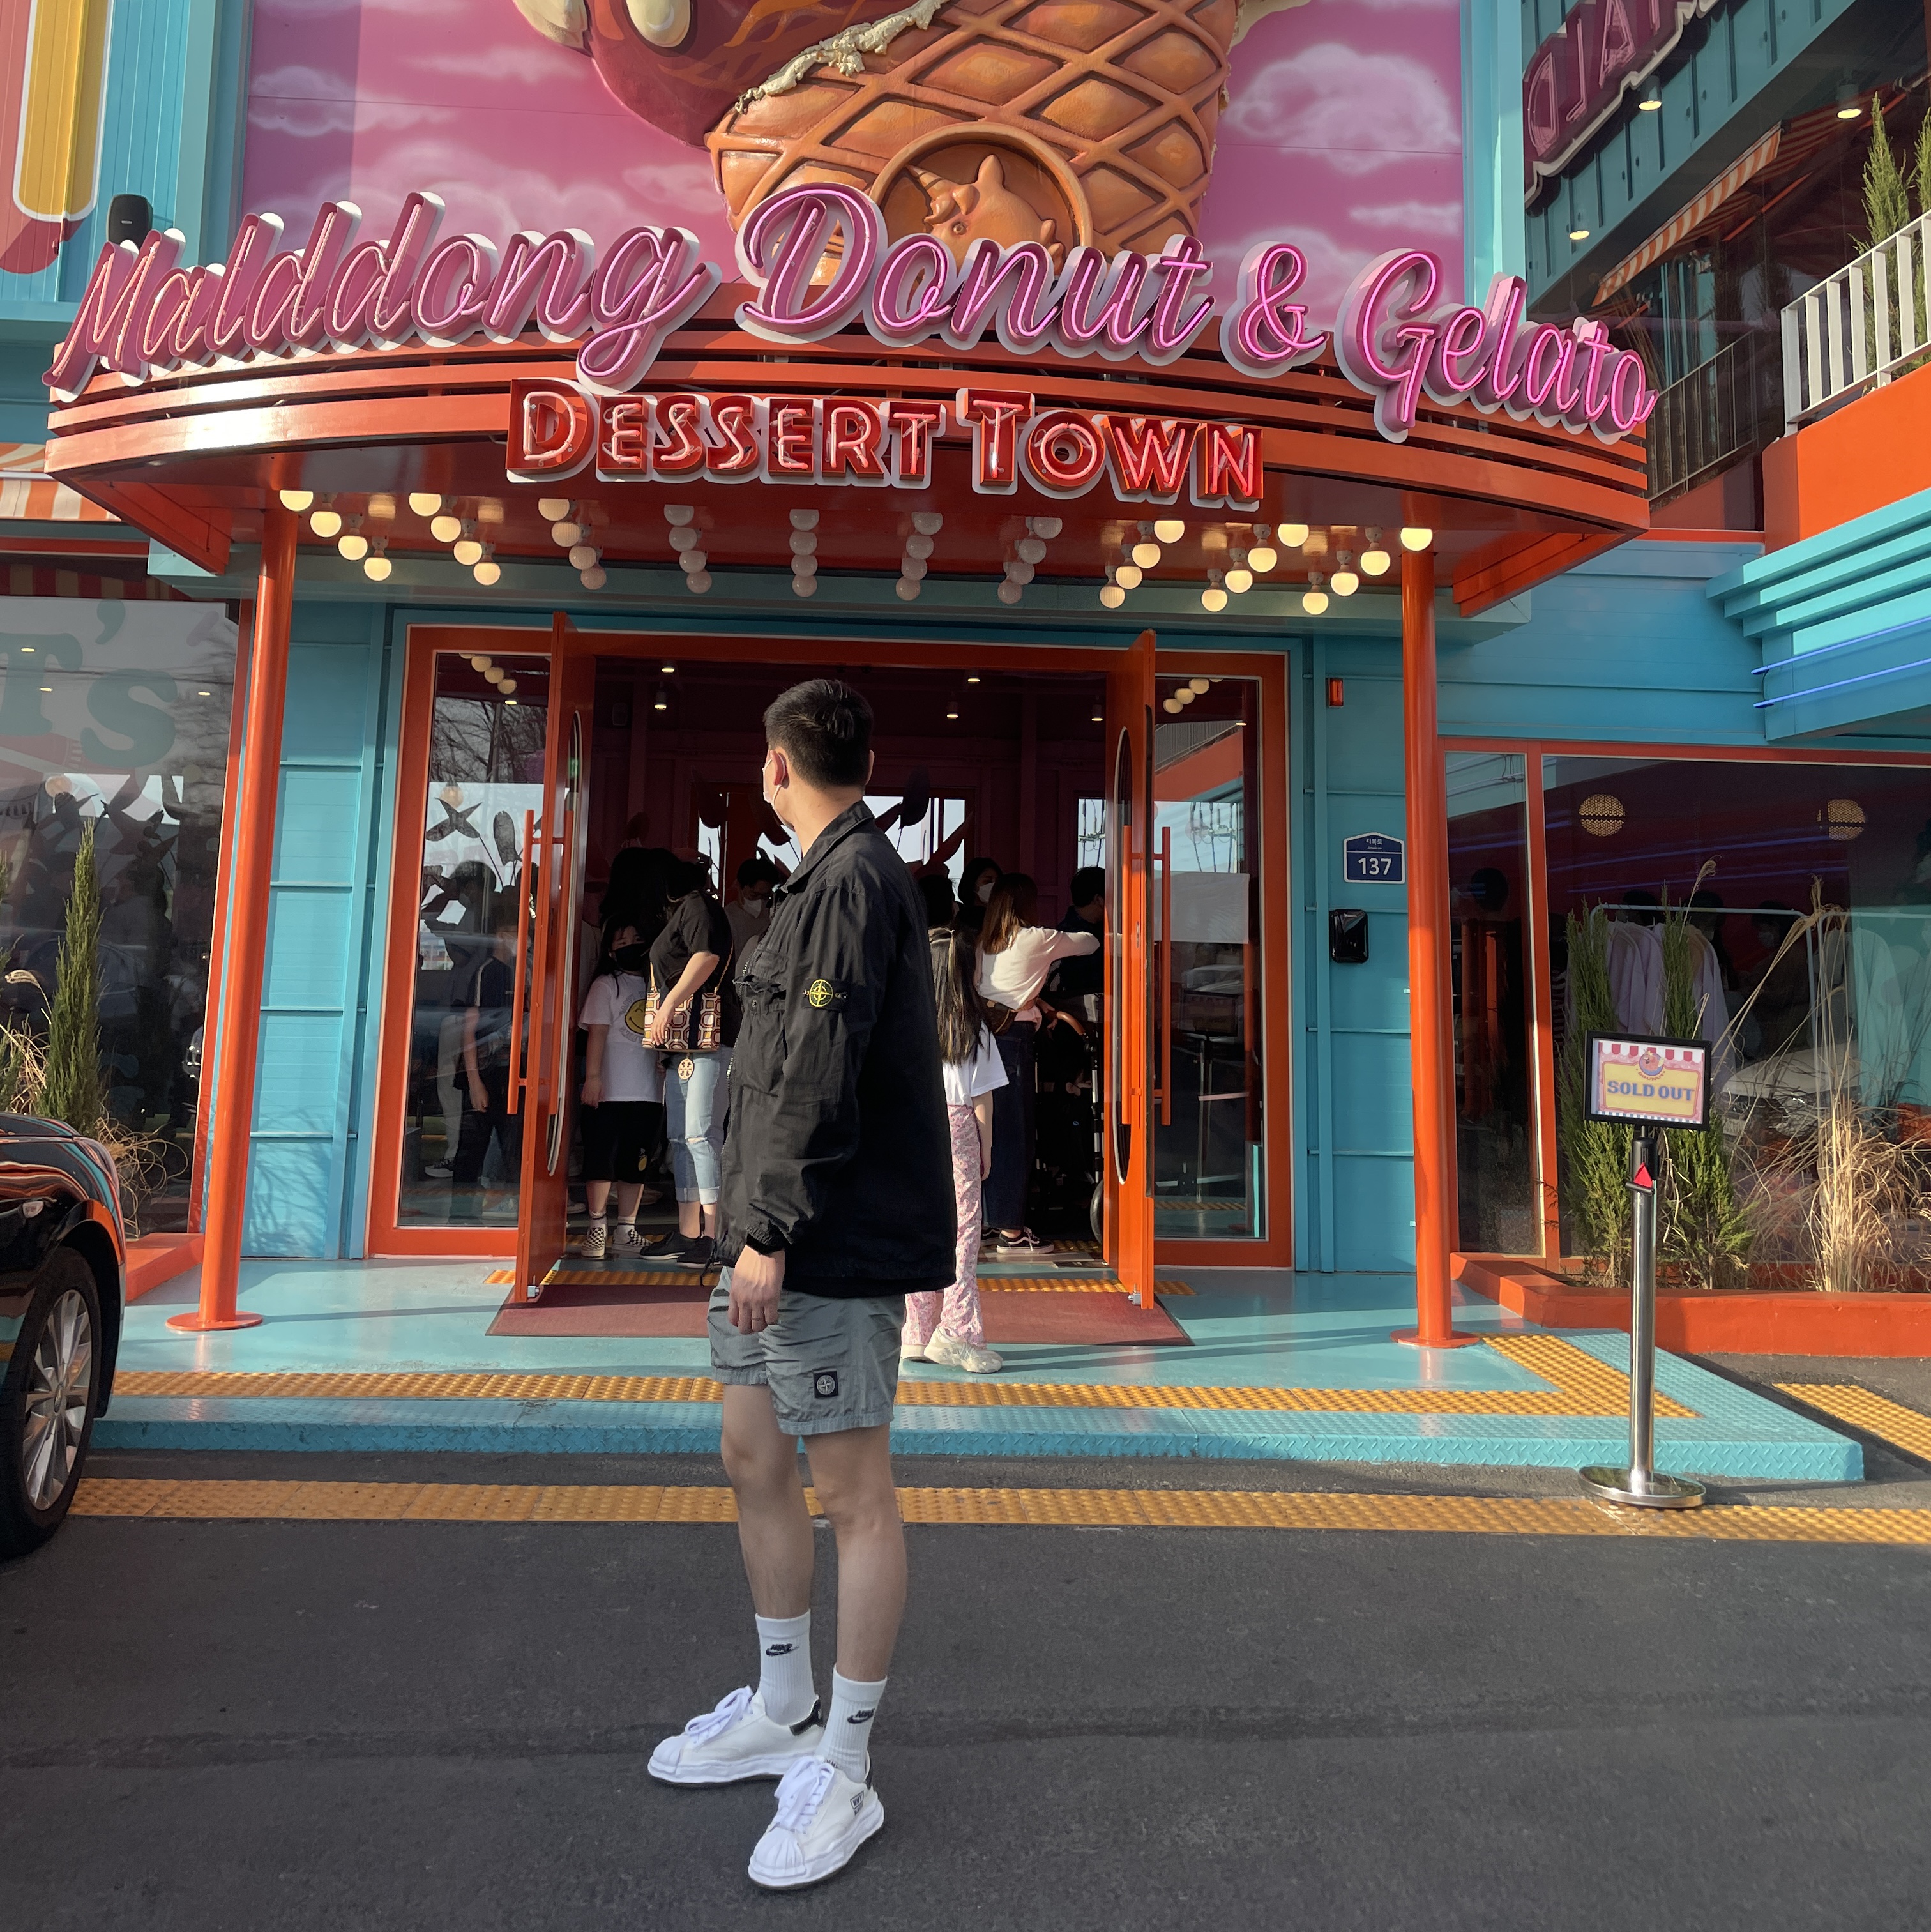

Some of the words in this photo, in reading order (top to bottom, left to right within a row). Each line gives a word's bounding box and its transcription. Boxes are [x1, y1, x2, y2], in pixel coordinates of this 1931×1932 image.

[42, 192, 719, 392] Malddong
[736, 183, 1216, 361] Donut
[1227, 243, 1329, 374] &
[1338, 248, 1658, 441] Gelato
[507, 379, 944, 487] DESSERT
[958, 388, 1262, 509] TOWN
[1358, 857, 1392, 876] 137
[1607, 1081, 1655, 1097] SOLD
[1658, 1086, 1695, 1101] OUT
